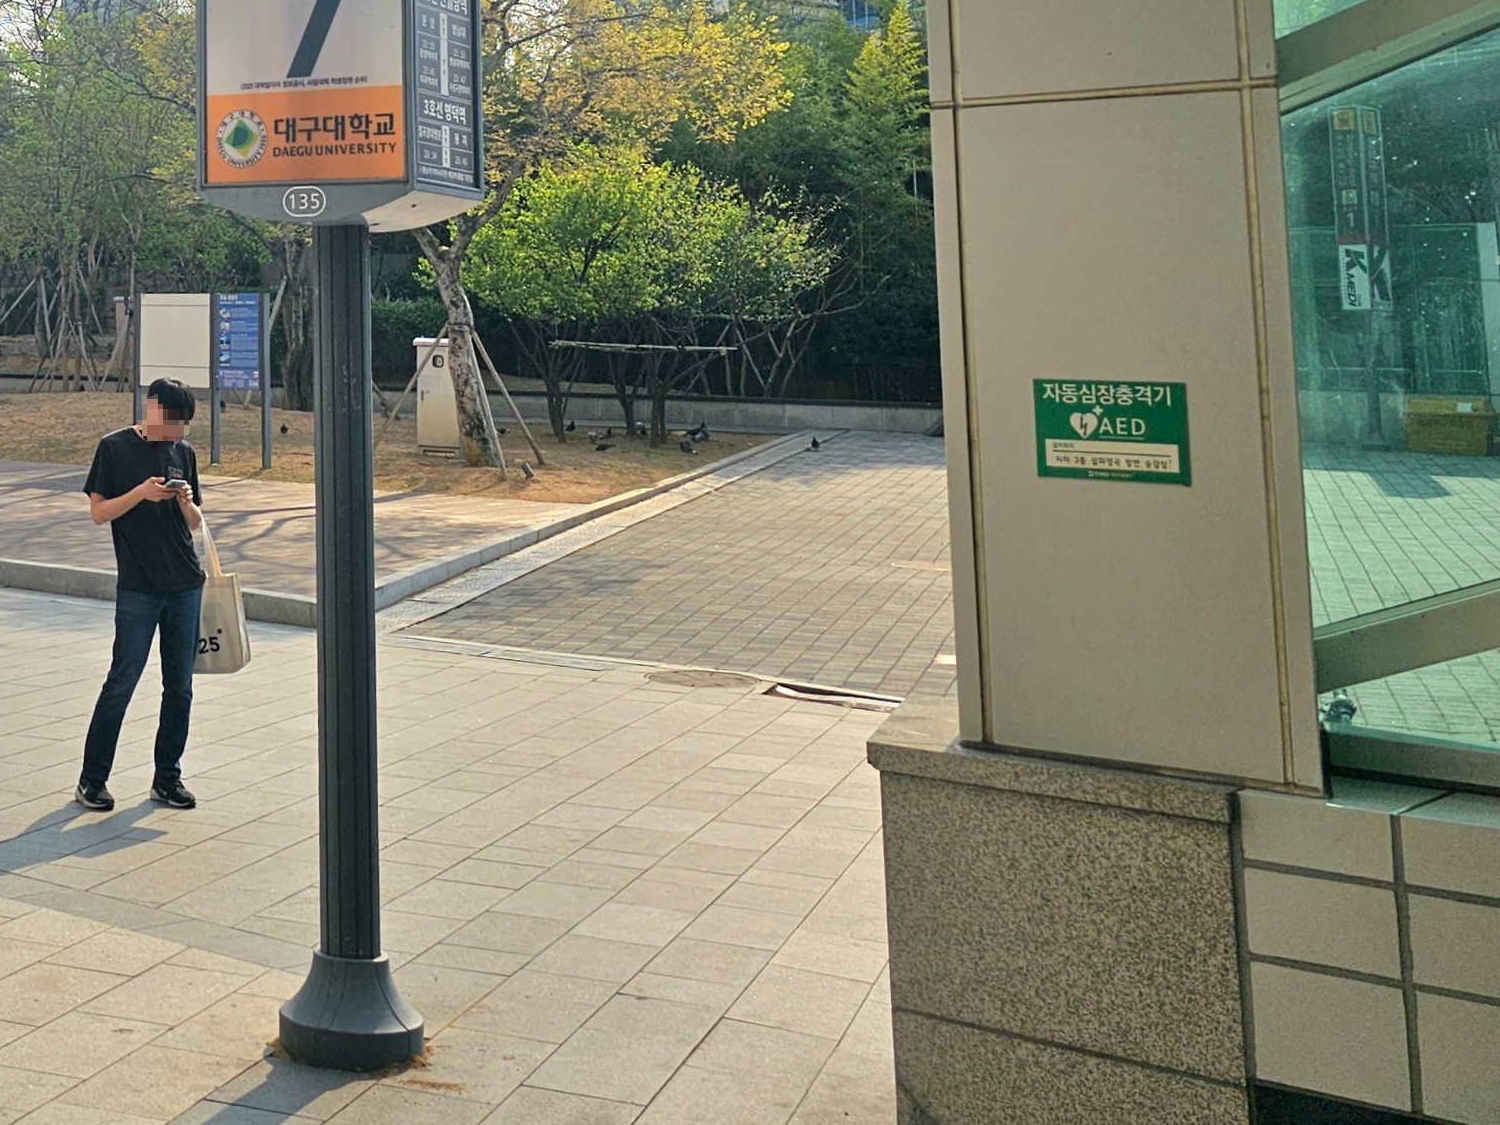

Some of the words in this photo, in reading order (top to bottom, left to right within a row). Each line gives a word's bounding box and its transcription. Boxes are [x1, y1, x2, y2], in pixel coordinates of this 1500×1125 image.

[423, 99, 443, 120] 3호선
[444, 103, 466, 125] 명덕역
[274, 113, 396, 143] 대구대학교
[273, 145, 315, 157] DAEGU
[315, 142, 397, 156] UNIVERSITY
[287, 192, 321, 210] 135
[1042, 383, 1171, 407] 자동심장충격기
[1099, 418, 1146, 435] AED
